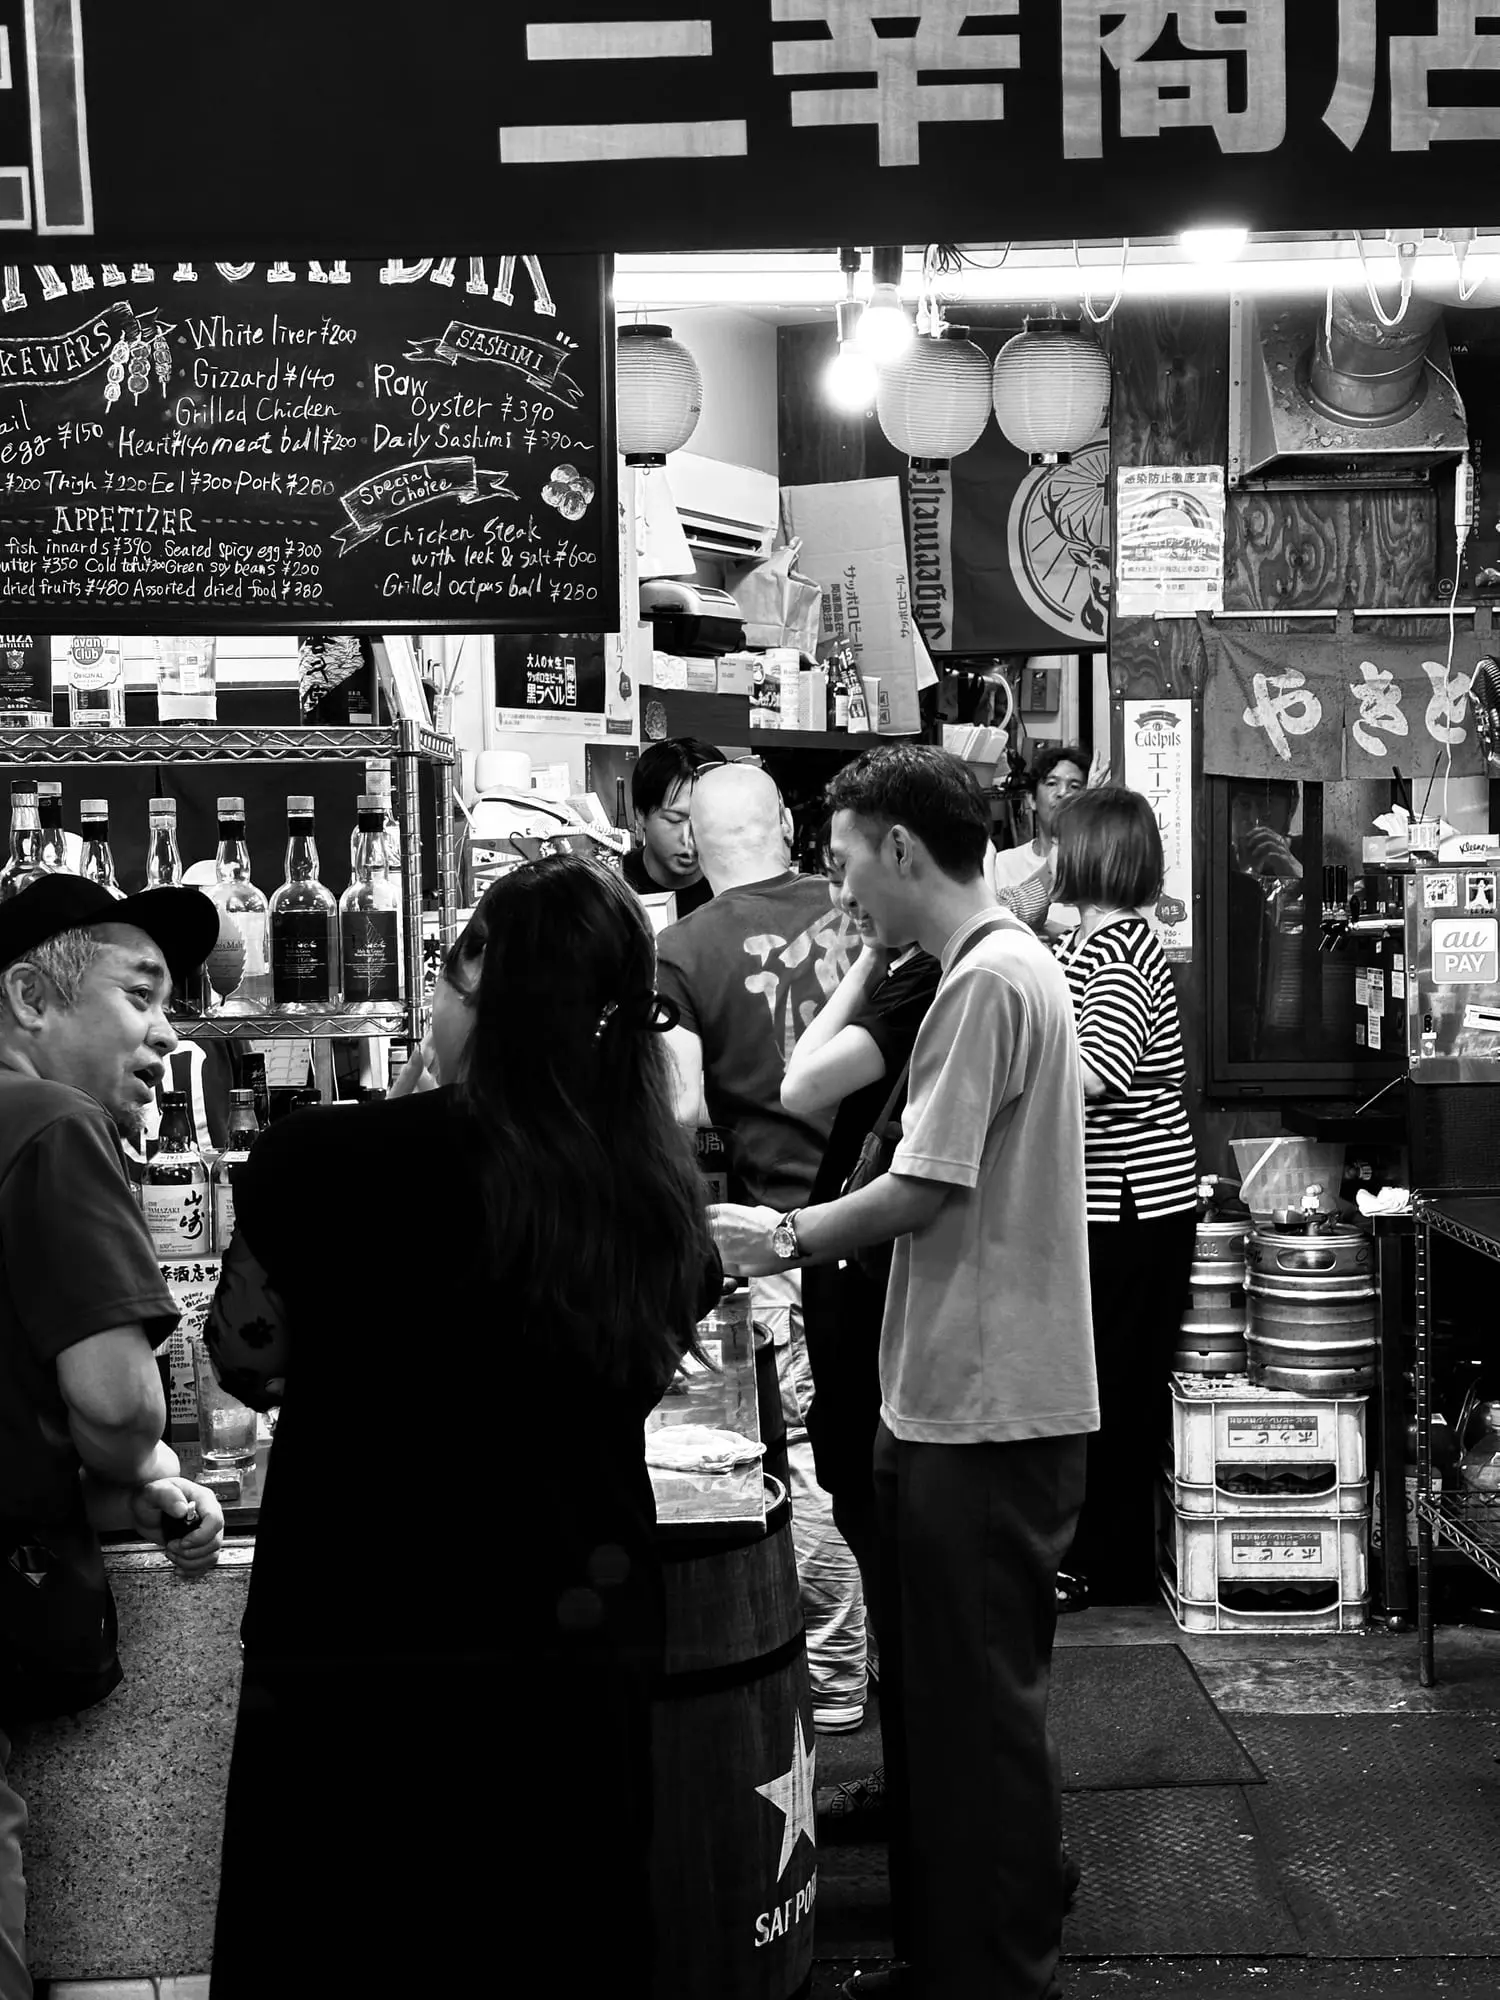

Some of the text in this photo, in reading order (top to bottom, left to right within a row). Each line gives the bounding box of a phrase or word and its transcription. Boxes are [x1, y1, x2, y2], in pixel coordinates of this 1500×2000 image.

[186, 314, 357, 350] White liver ¥200
[456, 329, 543, 371] SASHIMI
[194, 358, 335, 390] Gizzard ¥140
[374, 364, 428, 397] Raw
[176, 395, 341, 426] Grilled Chicken
[411, 392, 554, 426] Oyster ¥390
[1, 422, 103, 465] egg ¥150
[119, 426, 170, 458] Heart
[211, 438, 273, 454] meat
[280, 425, 319, 452] ball
[374, 424, 431, 458] Daily
[438, 418, 512, 449] Sashimi
[5, 474, 40, 493] ¥200
[43, 470, 97, 495] Thigh
[152, 470, 184, 493] Eel
[235, 470, 282, 495] Pork
[360, 464, 431, 505] Special
[391, 481, 452, 506] Choice
[52, 506, 197, 535] APPETIZER
[385, 520, 474, 547] Chicken
[5, 537, 39, 556] fish
[164, 538, 211, 558] Seared
[218, 542, 253, 560] spicy
[257, 545, 280, 561] egg
[412, 540, 597, 568] with leek & salt ¥600
[85, 557, 116, 572] Cold
[122, 559, 145, 574] tofu
[165, 560, 204, 574] Green
[210, 561, 230, 576] soy
[234, 560, 275, 576] beans
[3, 582, 35, 597] dried
[39, 579, 82, 597] fruits
[133, 578, 196, 597] Assorted
[203, 583, 243, 598] dried
[247, 579, 277, 598] food
[382, 572, 442, 597] Grilled
[508, 573, 542, 598] ball
[550, 579, 598, 602] ¥280
[71, 637, 109, 661] avana Club
[526, 683, 566, 705] 黒ラベル
[1134, 732, 1182, 749] Edelpils
[1442, 931, 1488, 948] au
[1445, 954, 1486, 973] PAY
[1233, 1431, 1313, 1445] ホッピー
[1236, 1548, 1317, 1561] ホッピー
[755, 1864, 818, 1947] SAPPOR
